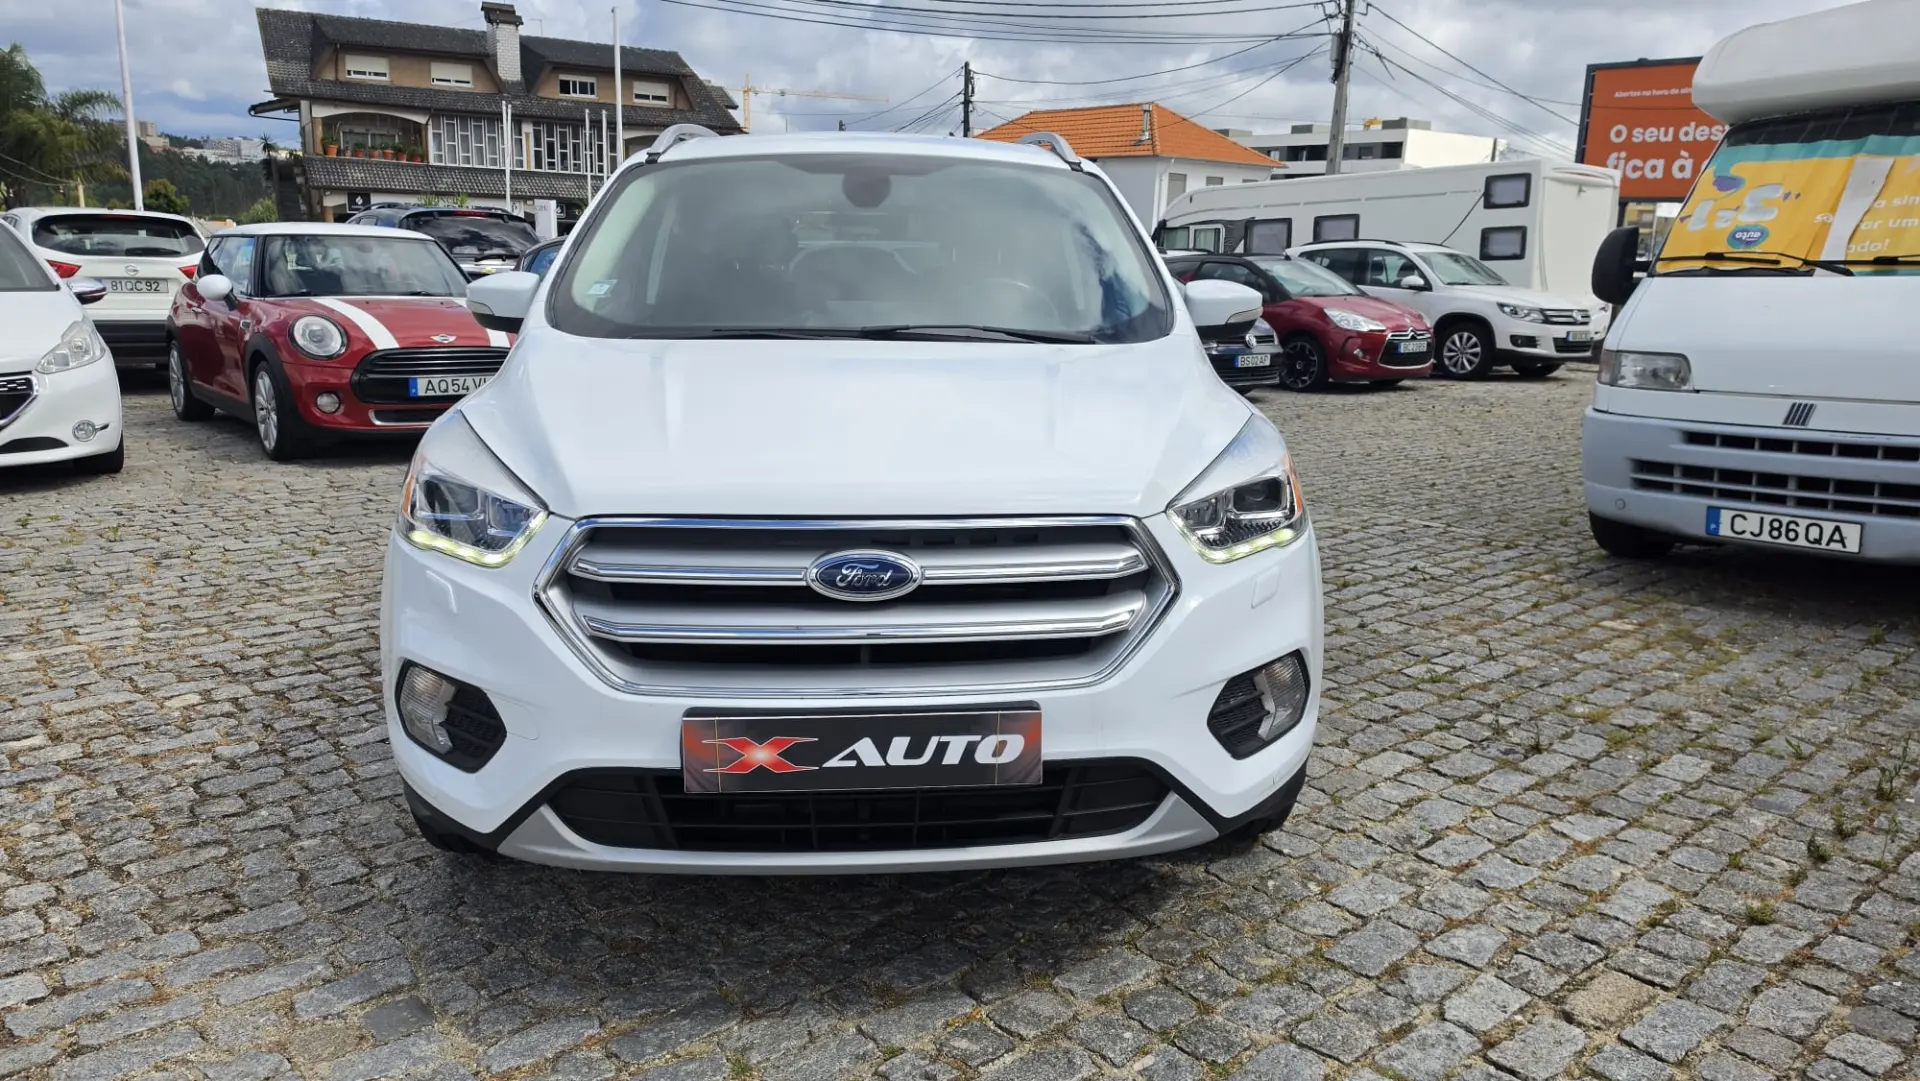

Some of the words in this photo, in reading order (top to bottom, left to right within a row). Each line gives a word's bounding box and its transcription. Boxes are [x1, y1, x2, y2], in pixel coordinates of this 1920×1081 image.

[1652, 88, 1669, 96] hora
[1670, 87, 1679, 95] de
[1610, 124, 1628, 143] O
[1632, 126, 1674, 143] seu
[1606, 151, 1665, 179] fica
[1671, 149, 1694, 179] à
[1888, 218, 1919, 228] um
[836, 563, 893, 587] Ford
[821, 734, 1025, 767] AUTO
